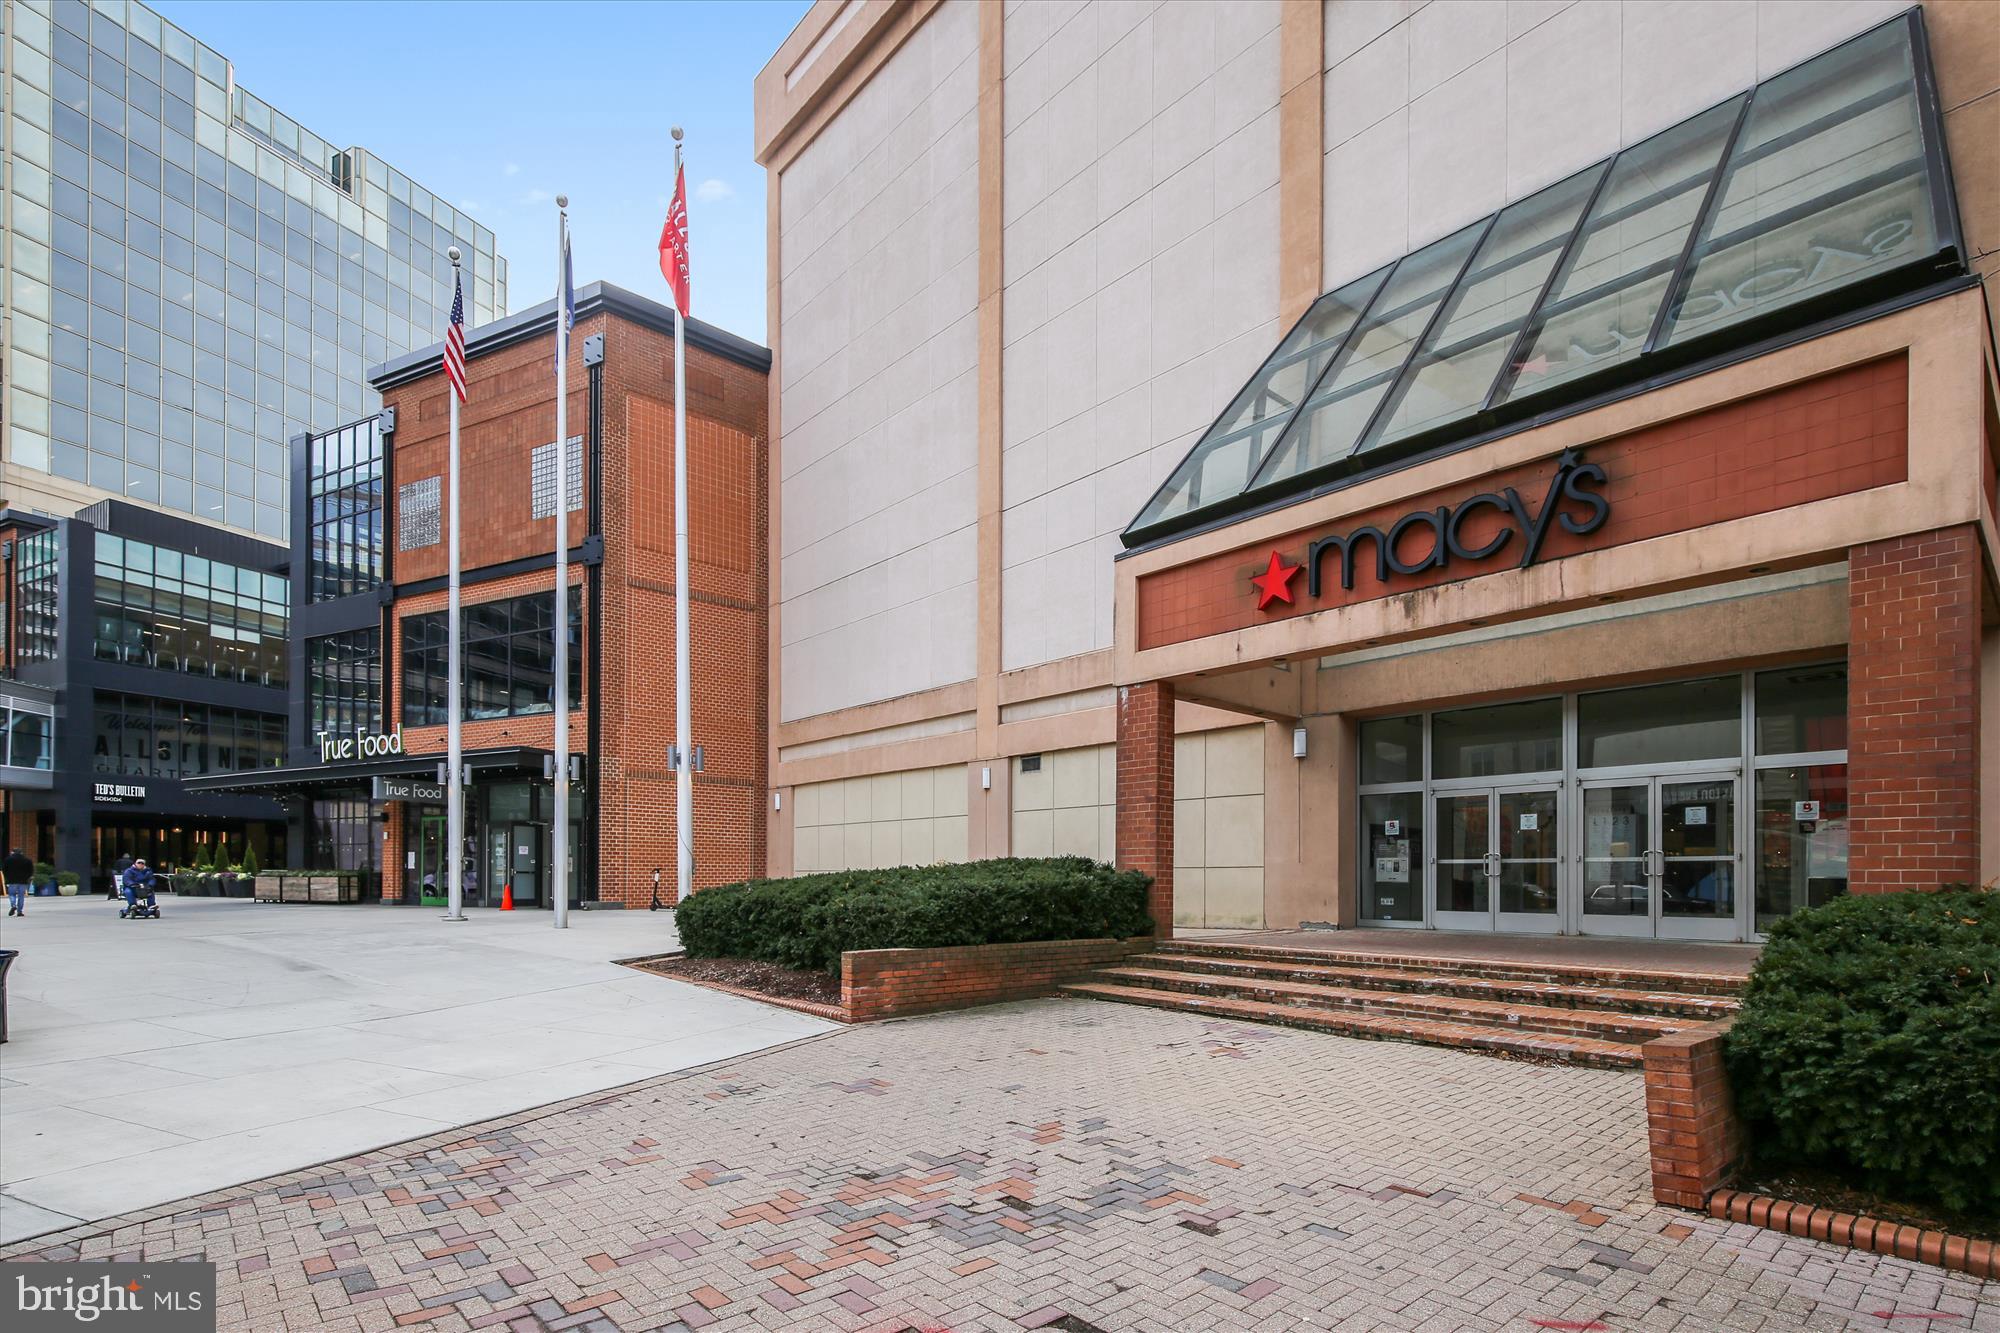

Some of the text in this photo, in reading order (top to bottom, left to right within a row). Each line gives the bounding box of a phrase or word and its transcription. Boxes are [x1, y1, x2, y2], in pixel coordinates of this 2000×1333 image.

[1308, 446, 1610, 597] macy's
[317, 722, 402, 763] True Food
[94, 783, 146, 798] TED'S BULLETIN
[383, 780, 442, 799] True Food
